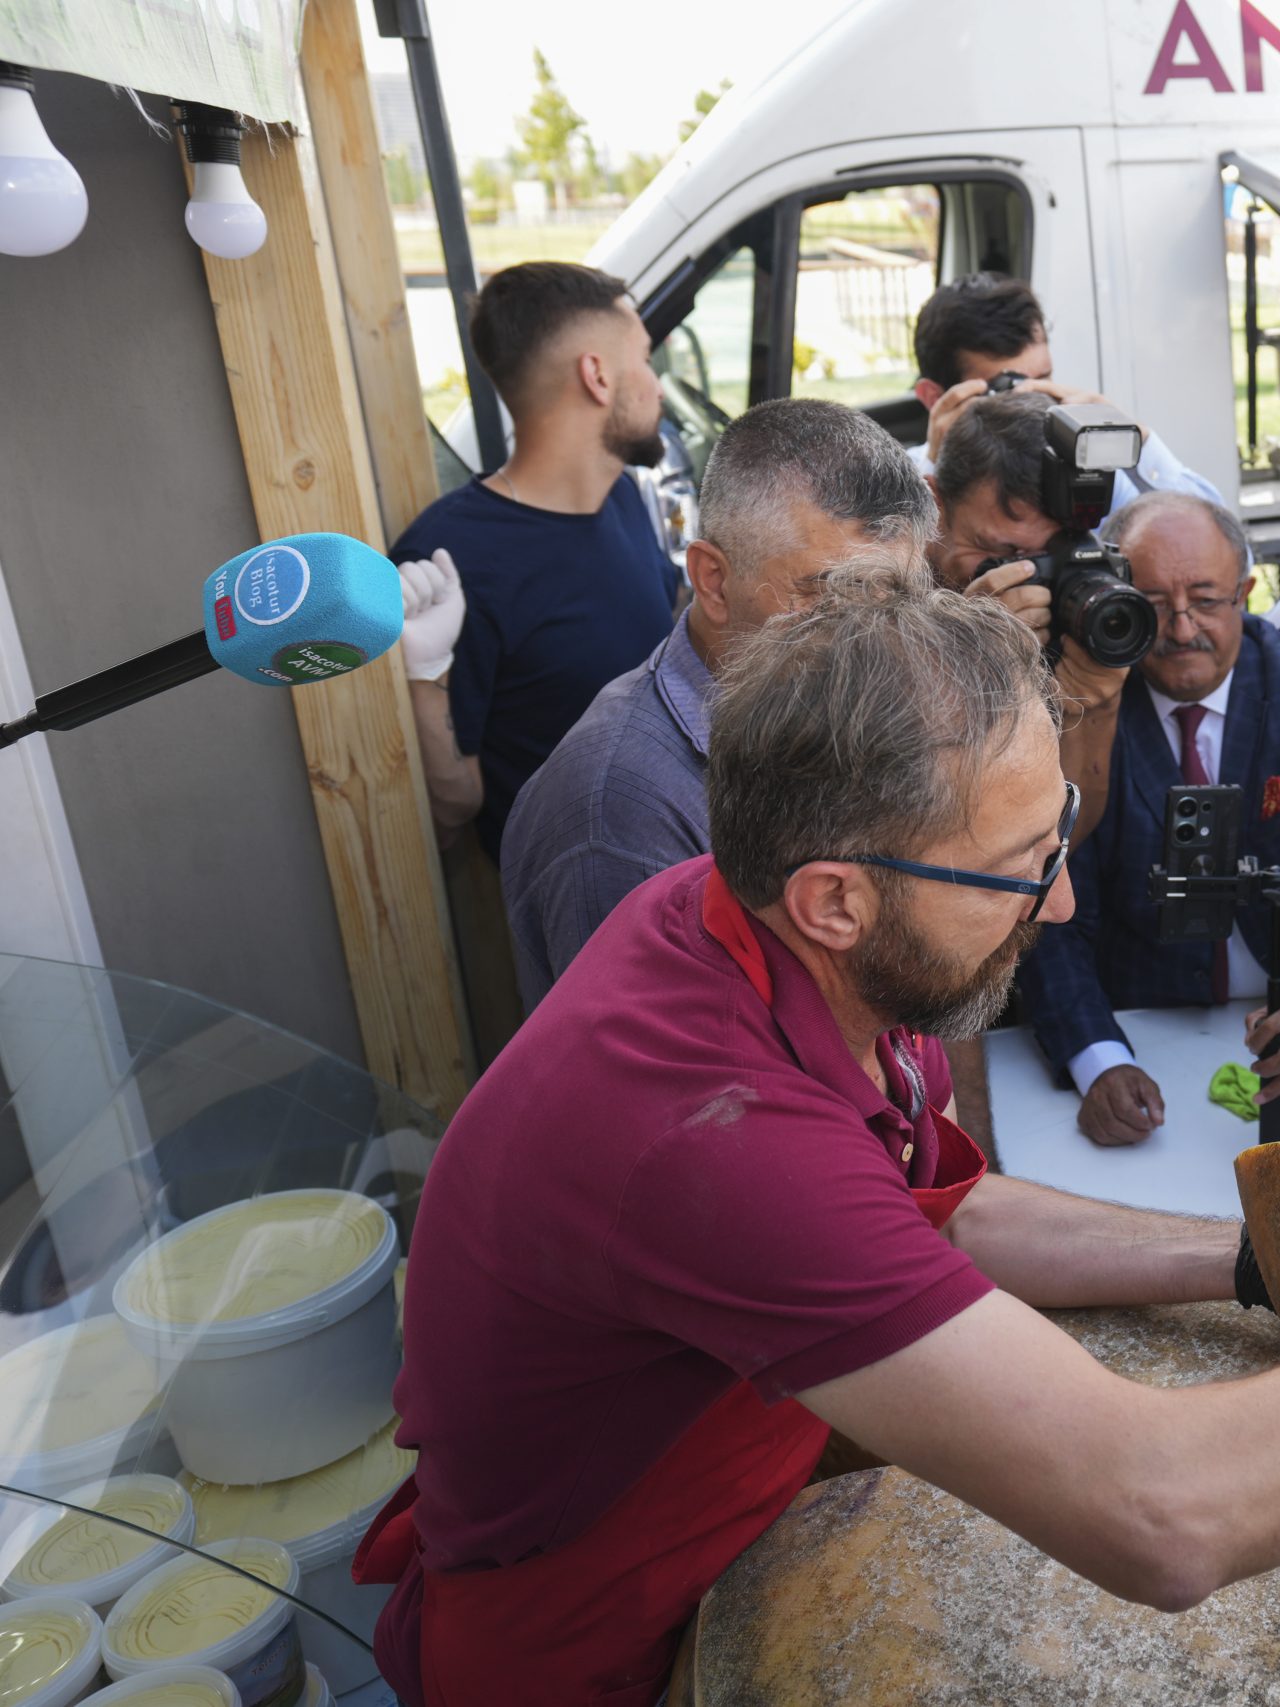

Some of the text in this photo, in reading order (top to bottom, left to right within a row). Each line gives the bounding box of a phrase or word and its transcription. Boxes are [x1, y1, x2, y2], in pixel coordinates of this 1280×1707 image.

[250, 567, 263, 608] Blog
[265, 551, 281, 614] isacotur
[257, 667, 294, 682] .com
[287, 659, 333, 677] AVM
